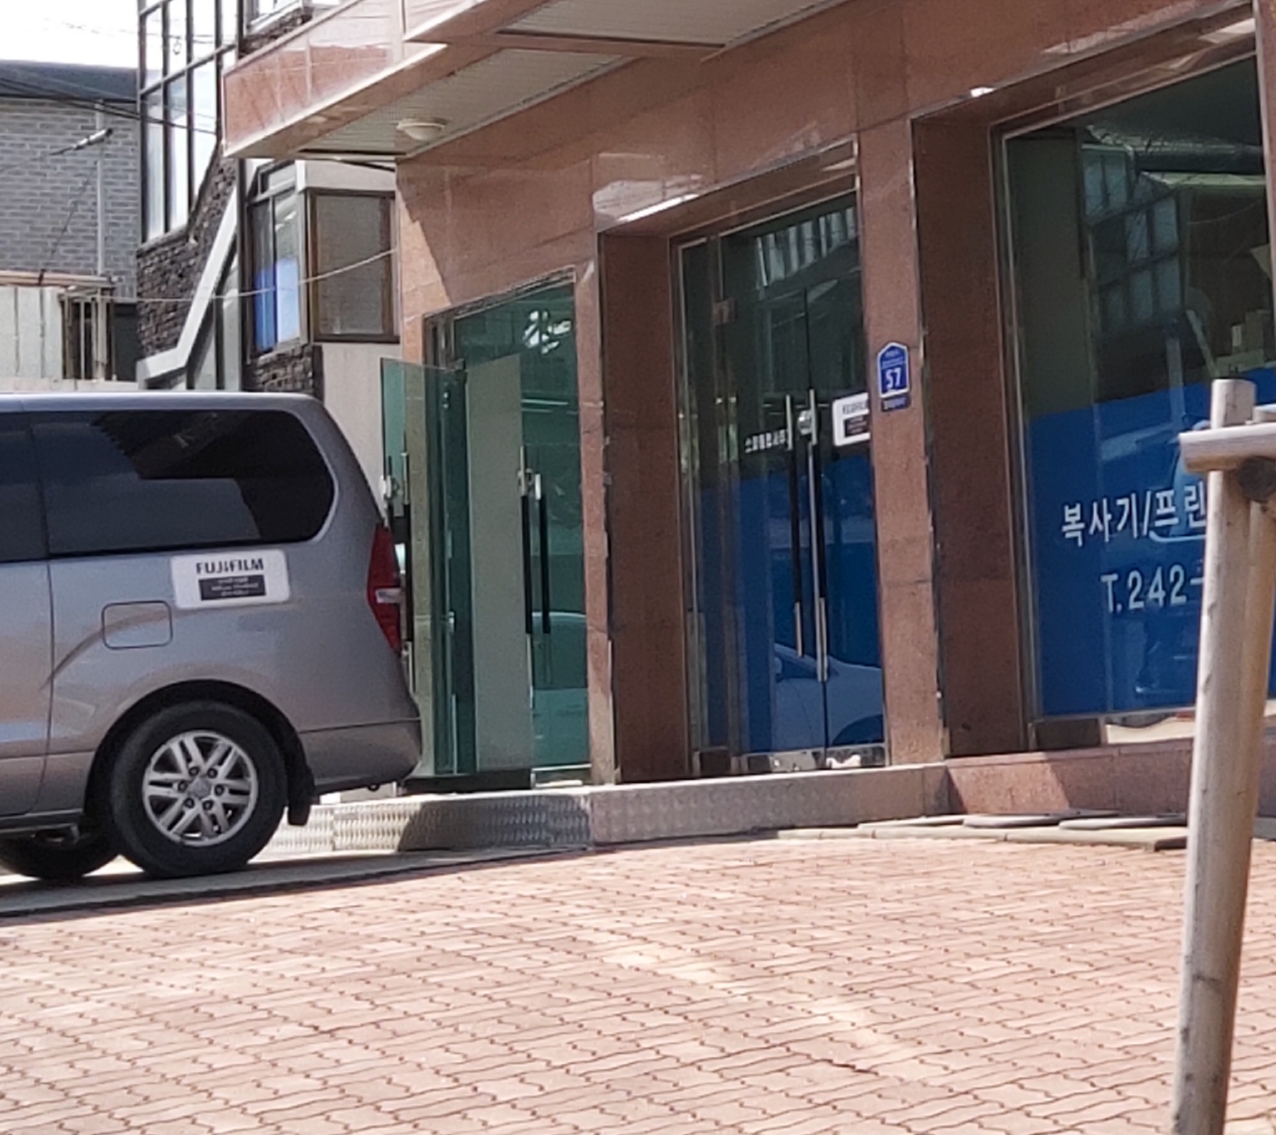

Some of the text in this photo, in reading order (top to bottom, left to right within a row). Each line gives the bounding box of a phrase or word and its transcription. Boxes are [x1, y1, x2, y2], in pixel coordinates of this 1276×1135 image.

[884, 366, 902, 390] 57
[1062, 479, 1209, 547] 복사기/프린
[196, 557, 265, 575] FUJIFILM
